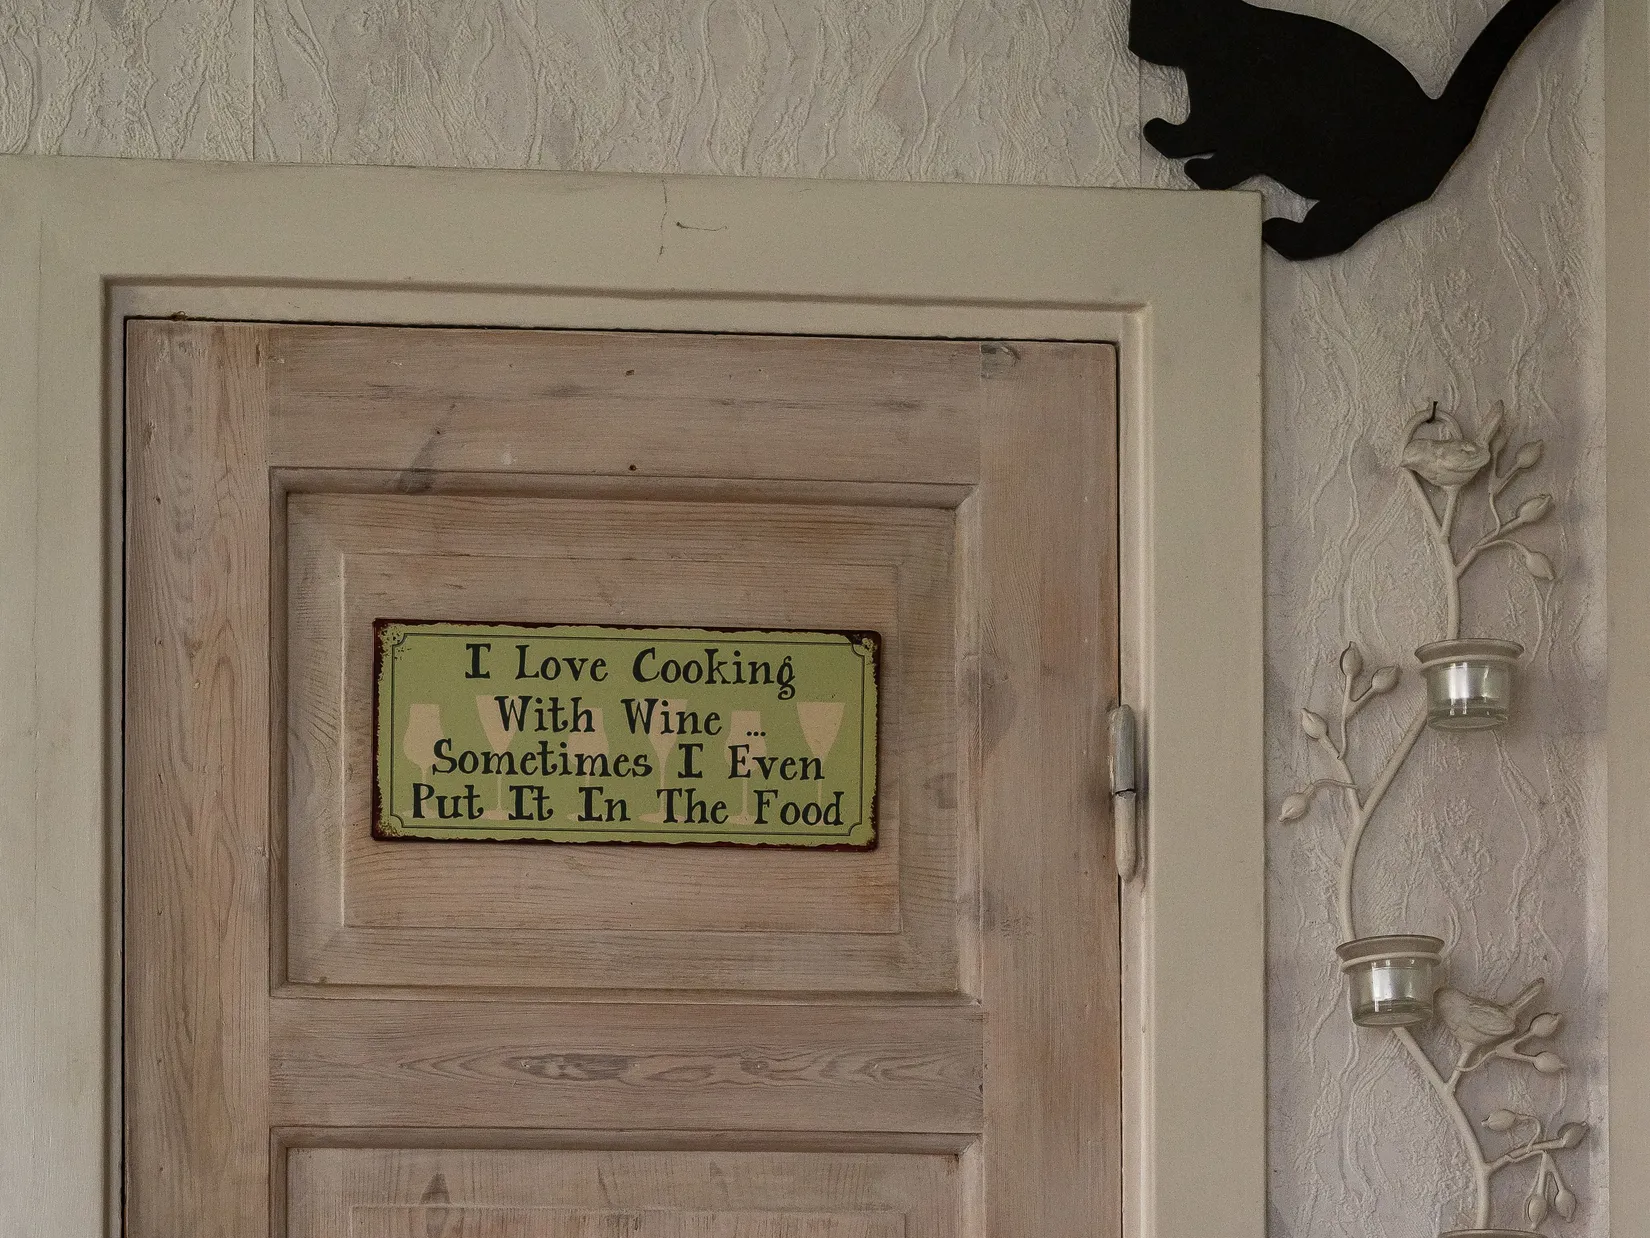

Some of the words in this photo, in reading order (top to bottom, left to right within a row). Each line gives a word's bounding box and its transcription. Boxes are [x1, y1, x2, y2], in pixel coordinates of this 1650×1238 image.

[465, 643, 491, 678] I
[515, 645, 608, 681] Love
[633, 647, 795, 700] Cooking
[494, 696, 595, 732] With
[621, 699, 722, 735] Wine
[432, 738, 652, 777] Sometimes
[678, 743, 703, 778] I
[728, 744, 825, 780] Even
[413, 783, 483, 819] Put
[509, 785, 553, 821] It
[578, 787, 631, 822] In
[657, 788, 728, 824] The
[753, 790, 844, 826] Food
